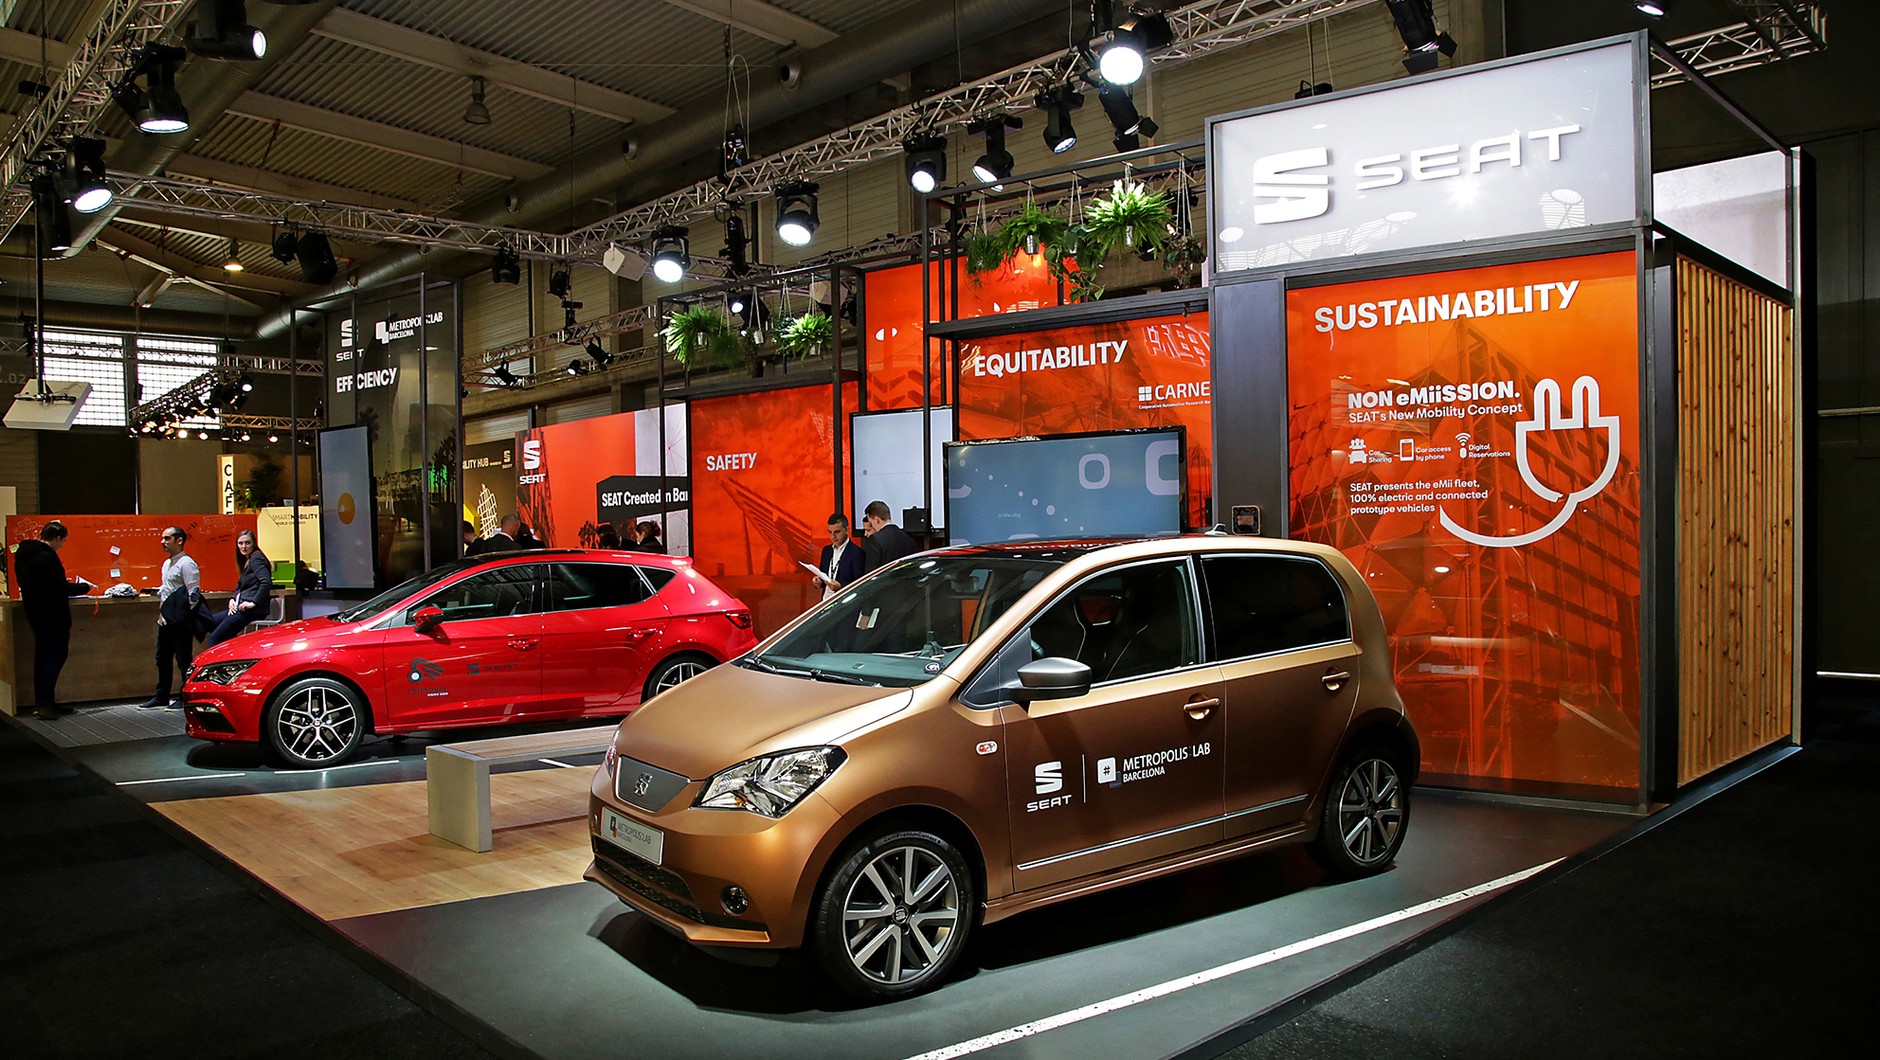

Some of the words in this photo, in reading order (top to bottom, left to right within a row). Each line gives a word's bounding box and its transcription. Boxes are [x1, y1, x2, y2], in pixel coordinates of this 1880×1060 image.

[1354, 123, 1580, 191] SEAT
[1314, 280, 1580, 333] SUSTAINABILITY
[336, 348, 364, 362] SET
[974, 339, 1128, 378] EQUITABILITY
[336, 367, 397, 393] EFFCIENCY
[1347, 390, 1393, 409] NON
[1396, 380, 1521, 406] eMiiSSION.
[1388, 409, 1414, 421] New
[1416, 406, 1465, 419] Mobility
[1467, 403, 1523, 416] Concept
[1468, 443, 1490, 451] Digital
[1468, 450, 1511, 459] Reservations
[706, 452, 757, 472] SAFETY
[1415, 454, 1425, 462] by
[1425, 453, 1445, 461] phone
[519, 474, 546, 485] SEAT
[1350, 482, 1372, 492] SEAT
[1373, 482, 1414, 492] presents
[1415, 480, 1431, 489] the
[1433, 479, 1453, 488] eMii
[1454, 478, 1480, 488] fleet,
[601, 492, 623, 507] SEAT
[623, 488, 661, 506] Created
[1350, 493, 1376, 503] 100%
[1378, 491, 1414, 502] electric
[1415, 491, 1434, 501] and
[1435, 489, 1488, 500] connected
[1350, 504, 1395, 515] prototype
[1396, 503, 1436, 513] vehicles
[1123, 766, 1166, 783] BARCELONA
[1026, 794, 1072, 812] SEAT
